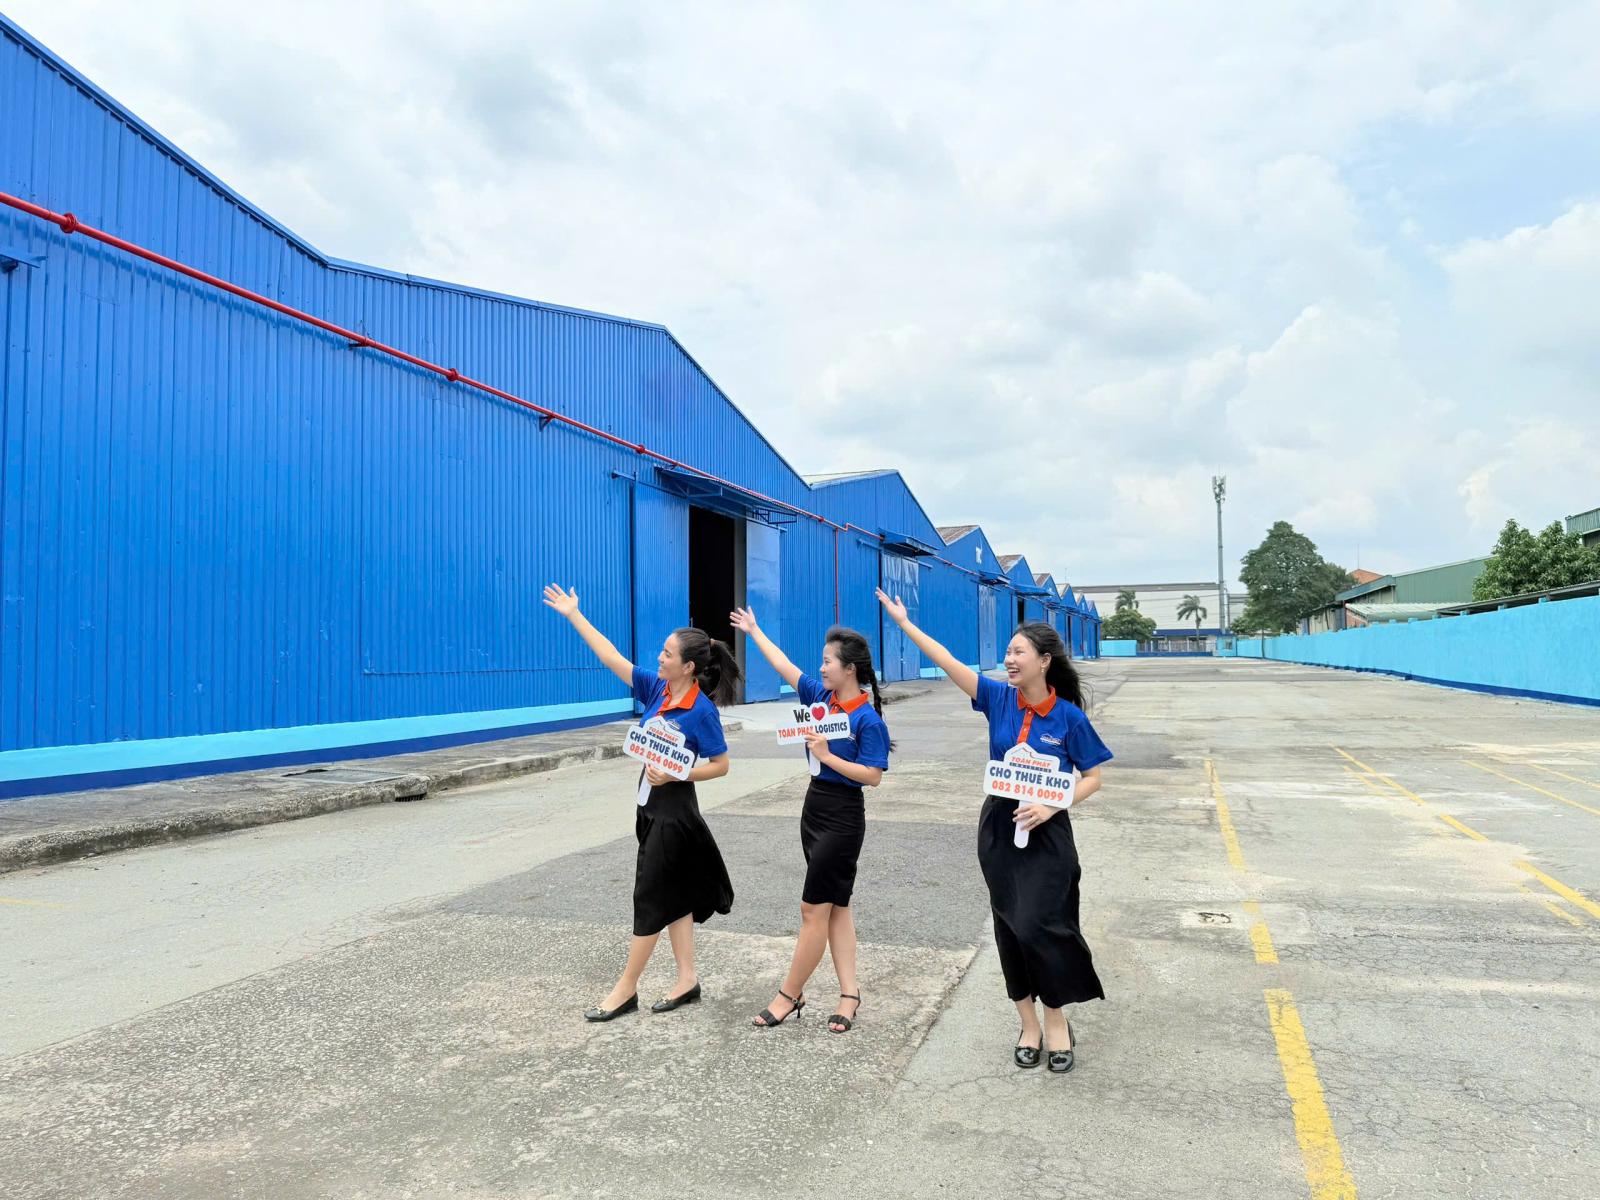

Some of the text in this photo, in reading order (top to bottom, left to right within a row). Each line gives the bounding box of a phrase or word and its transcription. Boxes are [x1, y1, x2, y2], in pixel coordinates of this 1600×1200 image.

[793, 709, 810, 723] We
[815, 722, 847, 733] LOGISTICS
[629, 743, 683, 773] 082 824 0099
[630, 731, 647, 744] CHO
[671, 750, 690, 765] KHO
[989, 766, 1011, 779] CHO
[1045, 776, 1070, 790] KHO
[992, 780, 1064, 801] 082 814 0099
